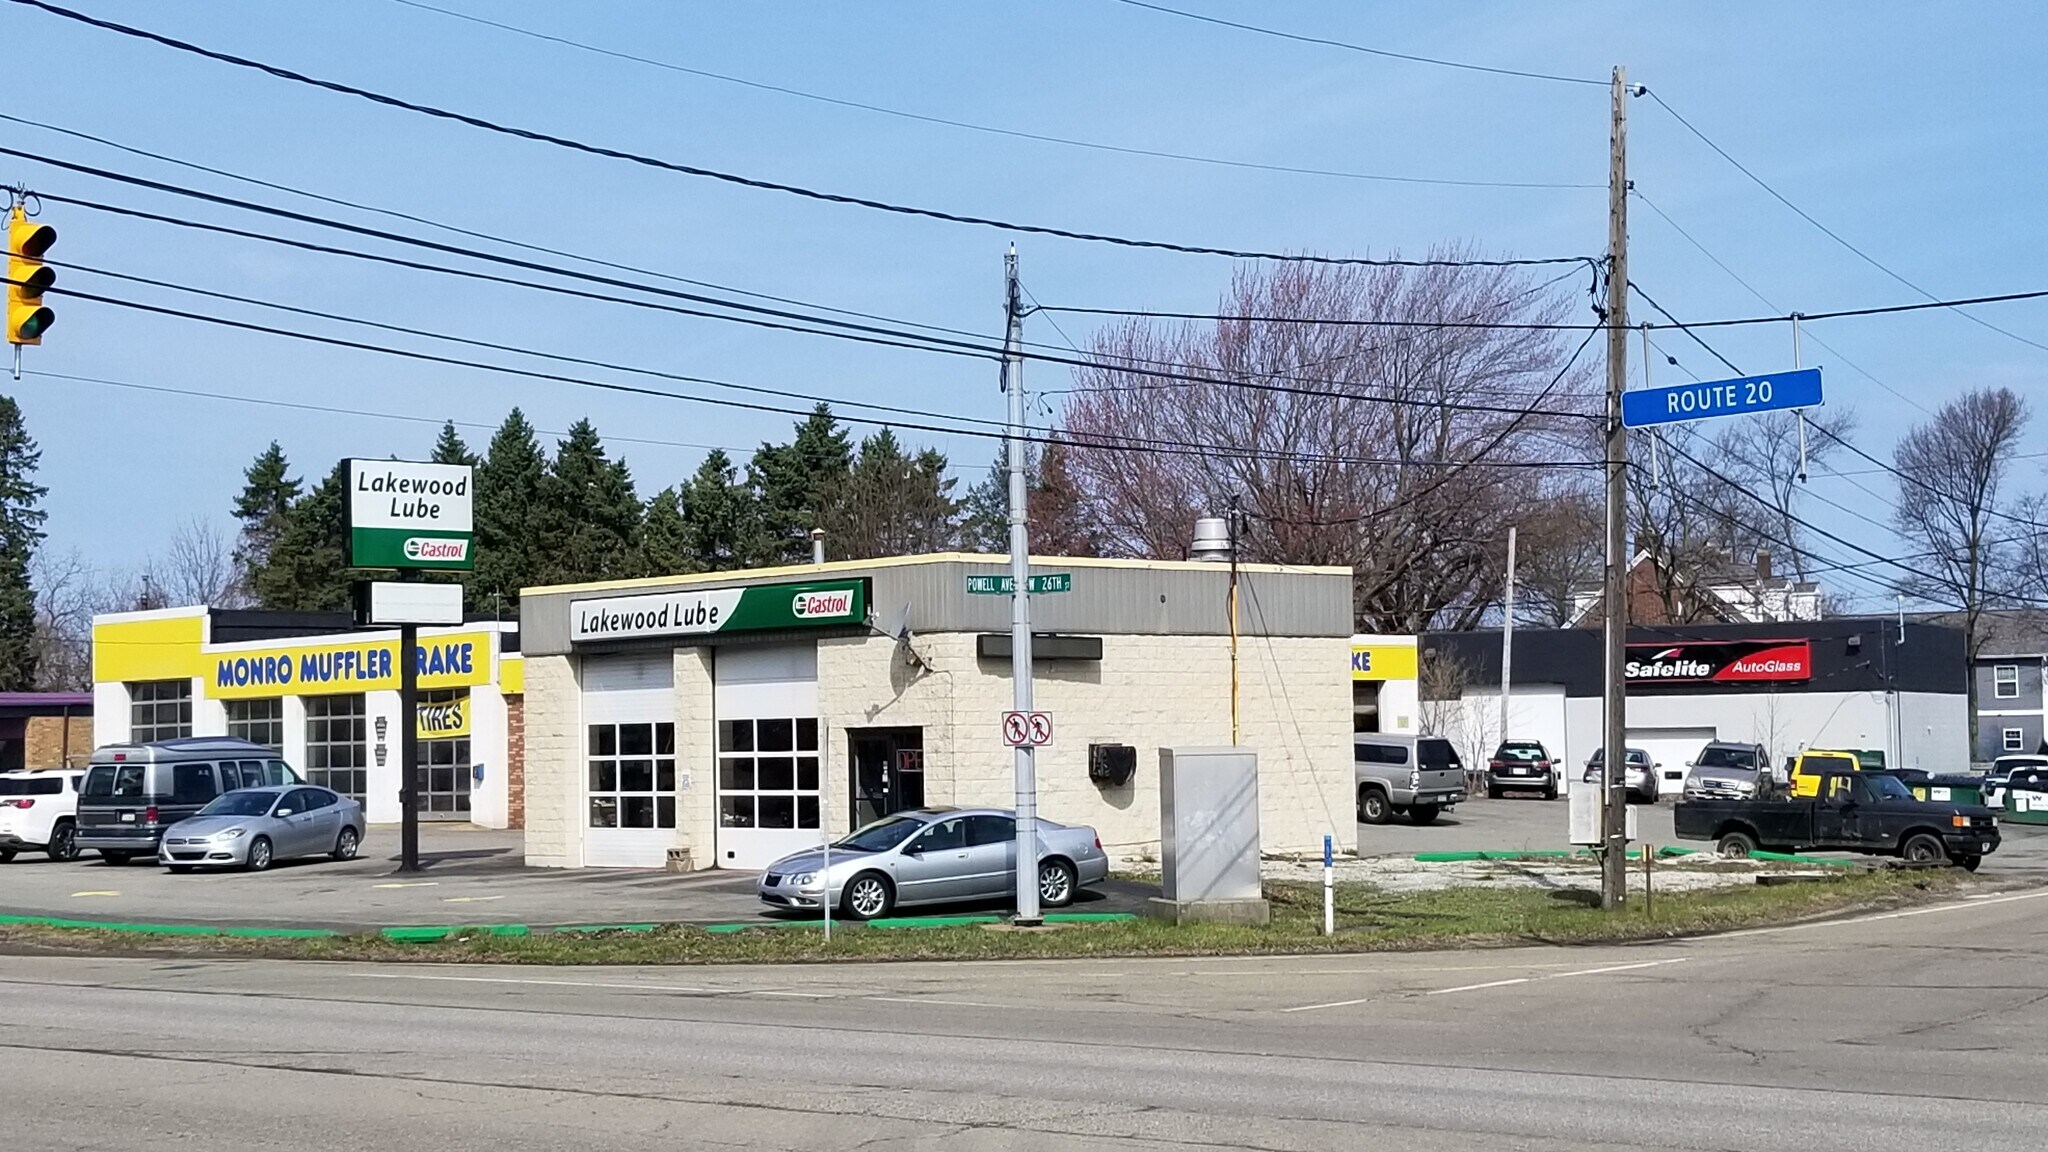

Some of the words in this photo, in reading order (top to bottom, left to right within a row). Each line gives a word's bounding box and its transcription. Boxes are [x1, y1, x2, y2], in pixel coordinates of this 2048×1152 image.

[1667, 384, 1736, 413] ROUTE
[1745, 380, 1773, 405] 20
[358, 471, 467, 496] Lakewood
[390, 497, 441, 518] Lube
[420, 541, 464, 558] Castrol
[967, 577, 995, 592] POWELL
[1000, 577, 1014, 592] AVE
[1028, 577, 1035, 591] W
[1042, 576, 1062, 591] 26TH
[806, 593, 848, 615] Castrol
[580, 602, 669, 634] Lakewood
[673, 599, 719, 628] Lube
[217, 655, 293, 687] MONRO
[300, 648, 392, 682] MUFFLER
[415, 642, 473, 678] RAKE
[1624, 659, 1710, 678] Safelite
[1732, 660, 1802, 674] AutoGlass
[417, 704, 463, 731] TIRES
[898, 751, 923, 769] OPE
